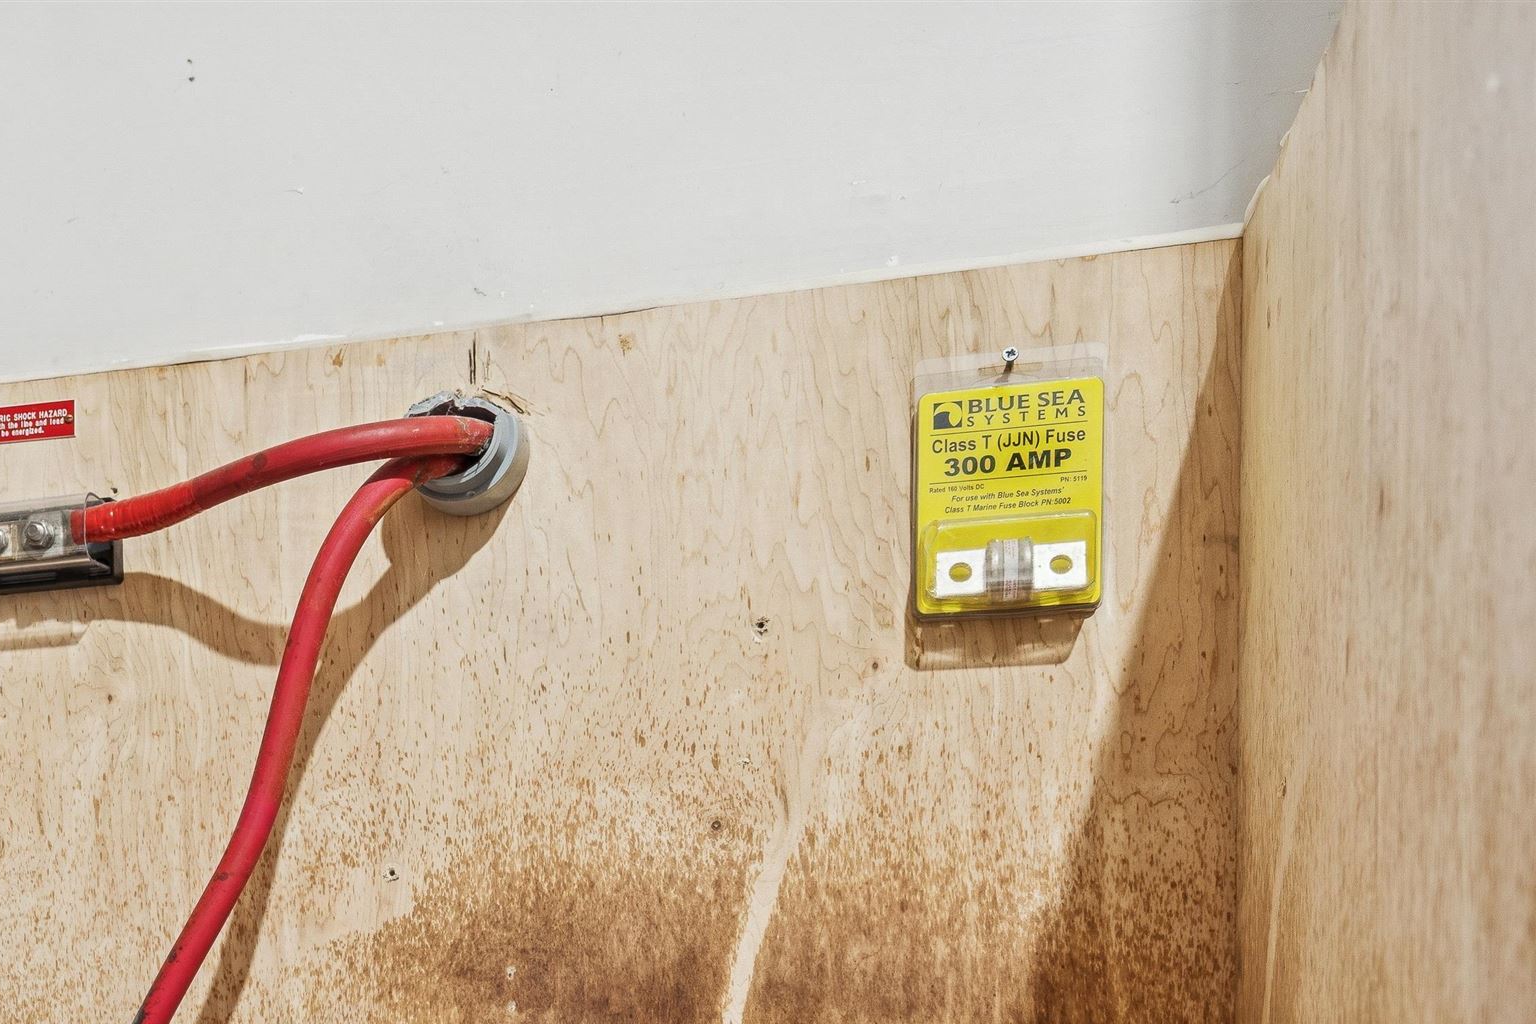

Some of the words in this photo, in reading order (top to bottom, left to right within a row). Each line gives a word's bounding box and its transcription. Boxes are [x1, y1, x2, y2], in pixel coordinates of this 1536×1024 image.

[968, 394, 1030, 414] BLUE
[1037, 389, 1086, 407] SEA
[14, 411, 36, 421] SHOCK
[38, 408, 68, 419] HAZARD
[967, 405, 1086, 427] SYSTEMS
[20, 420, 33, 428] line
[35, 418, 48, 426] and
[0, 430, 10, 438] be
[932, 438, 976, 454] Class
[982, 434, 992, 449] T
[997, 430, 1040, 451] (JJN)
[1046, 428, 1086, 444] Fuse
[944, 454, 996, 476] 300
[1006, 448, 1072, 472] AMP
[958, 484, 974, 492] Volts
[980, 492, 996, 500] with
[997, 491, 1014, 499] Blue
[1016, 490, 1030, 498] Sea
[944, 506, 964, 514] Class
[972, 504, 997, 512] Marine
[1018, 500, 1039, 508] Block
